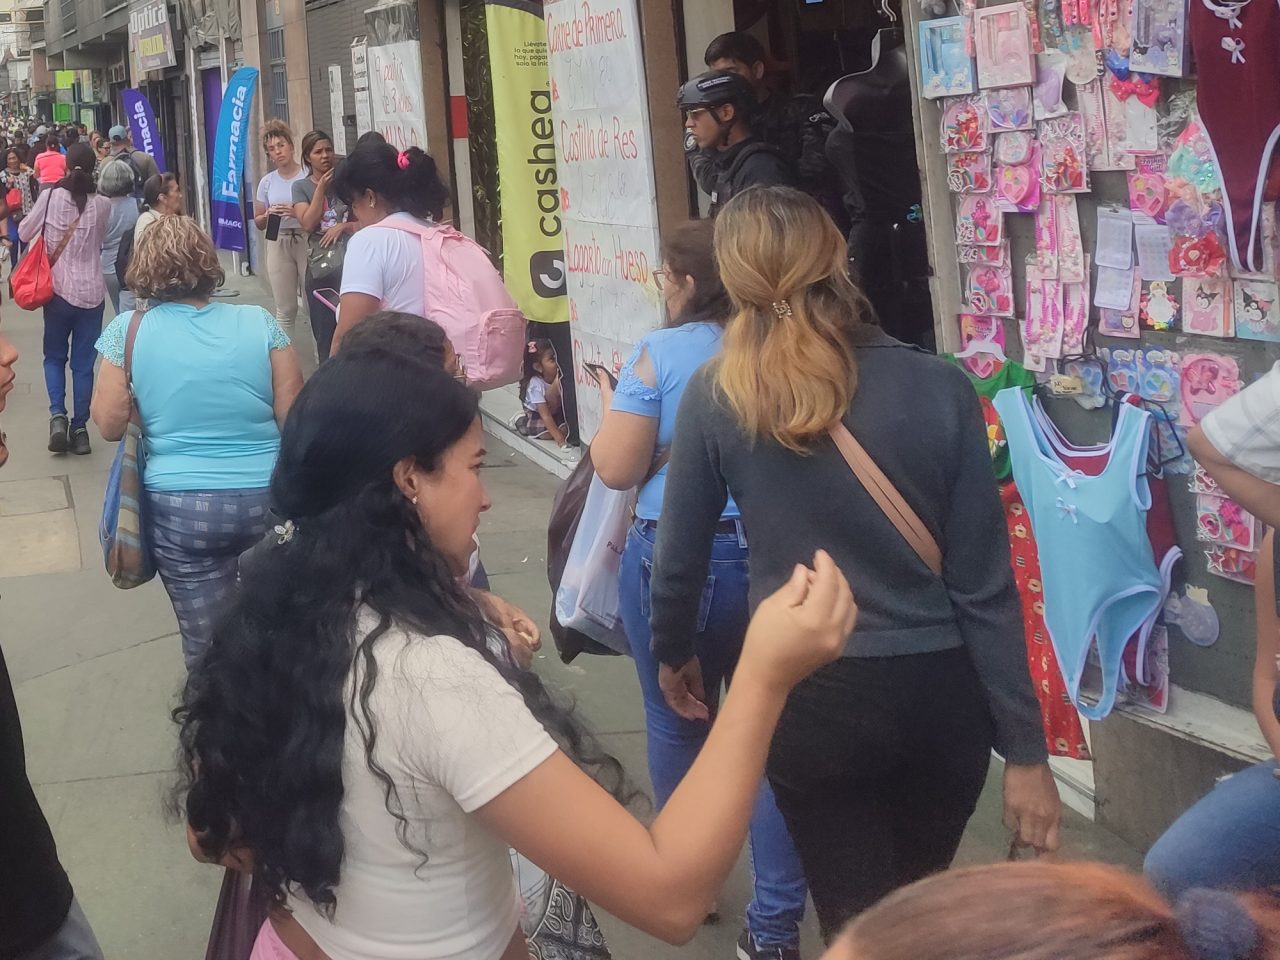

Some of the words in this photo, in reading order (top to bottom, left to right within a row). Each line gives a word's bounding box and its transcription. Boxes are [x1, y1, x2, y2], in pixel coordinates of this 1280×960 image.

[222, 85, 248, 199] Farmacia
[528, 90, 563, 238] cashea
[612, 116, 639, 161] Res
